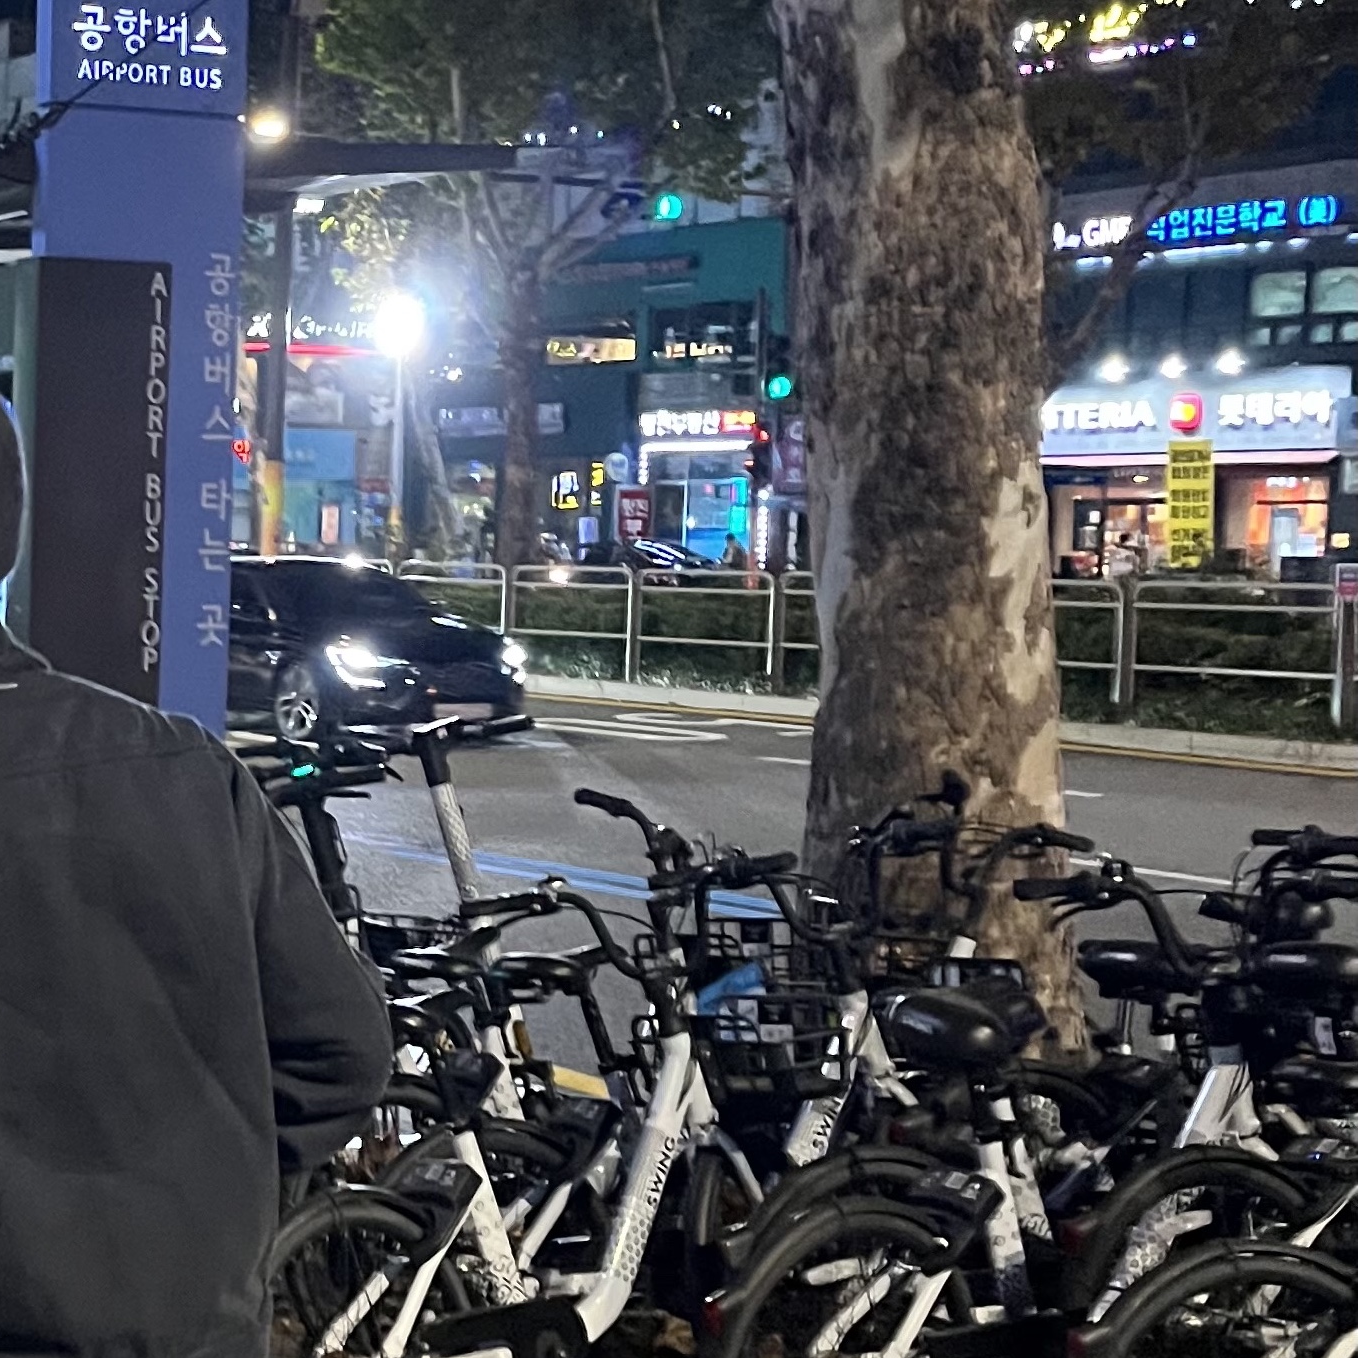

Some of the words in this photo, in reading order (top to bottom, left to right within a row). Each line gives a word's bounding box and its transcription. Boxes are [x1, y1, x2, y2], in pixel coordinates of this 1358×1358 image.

[72, 4, 228, 57] 공항버스
[77, 58, 172, 85] AIRPORT
[178, 66, 223, 91] BUS
[145, 270, 169, 459] AIRPORT
[201, 252, 237, 442] 공항버스
[145, 472, 162, 554] BUS
[197, 477, 234, 572] 타는
[140, 567, 161, 674] STOP
[196, 603, 229, 648] 곳
[646, 1135, 676, 1210] SWING
